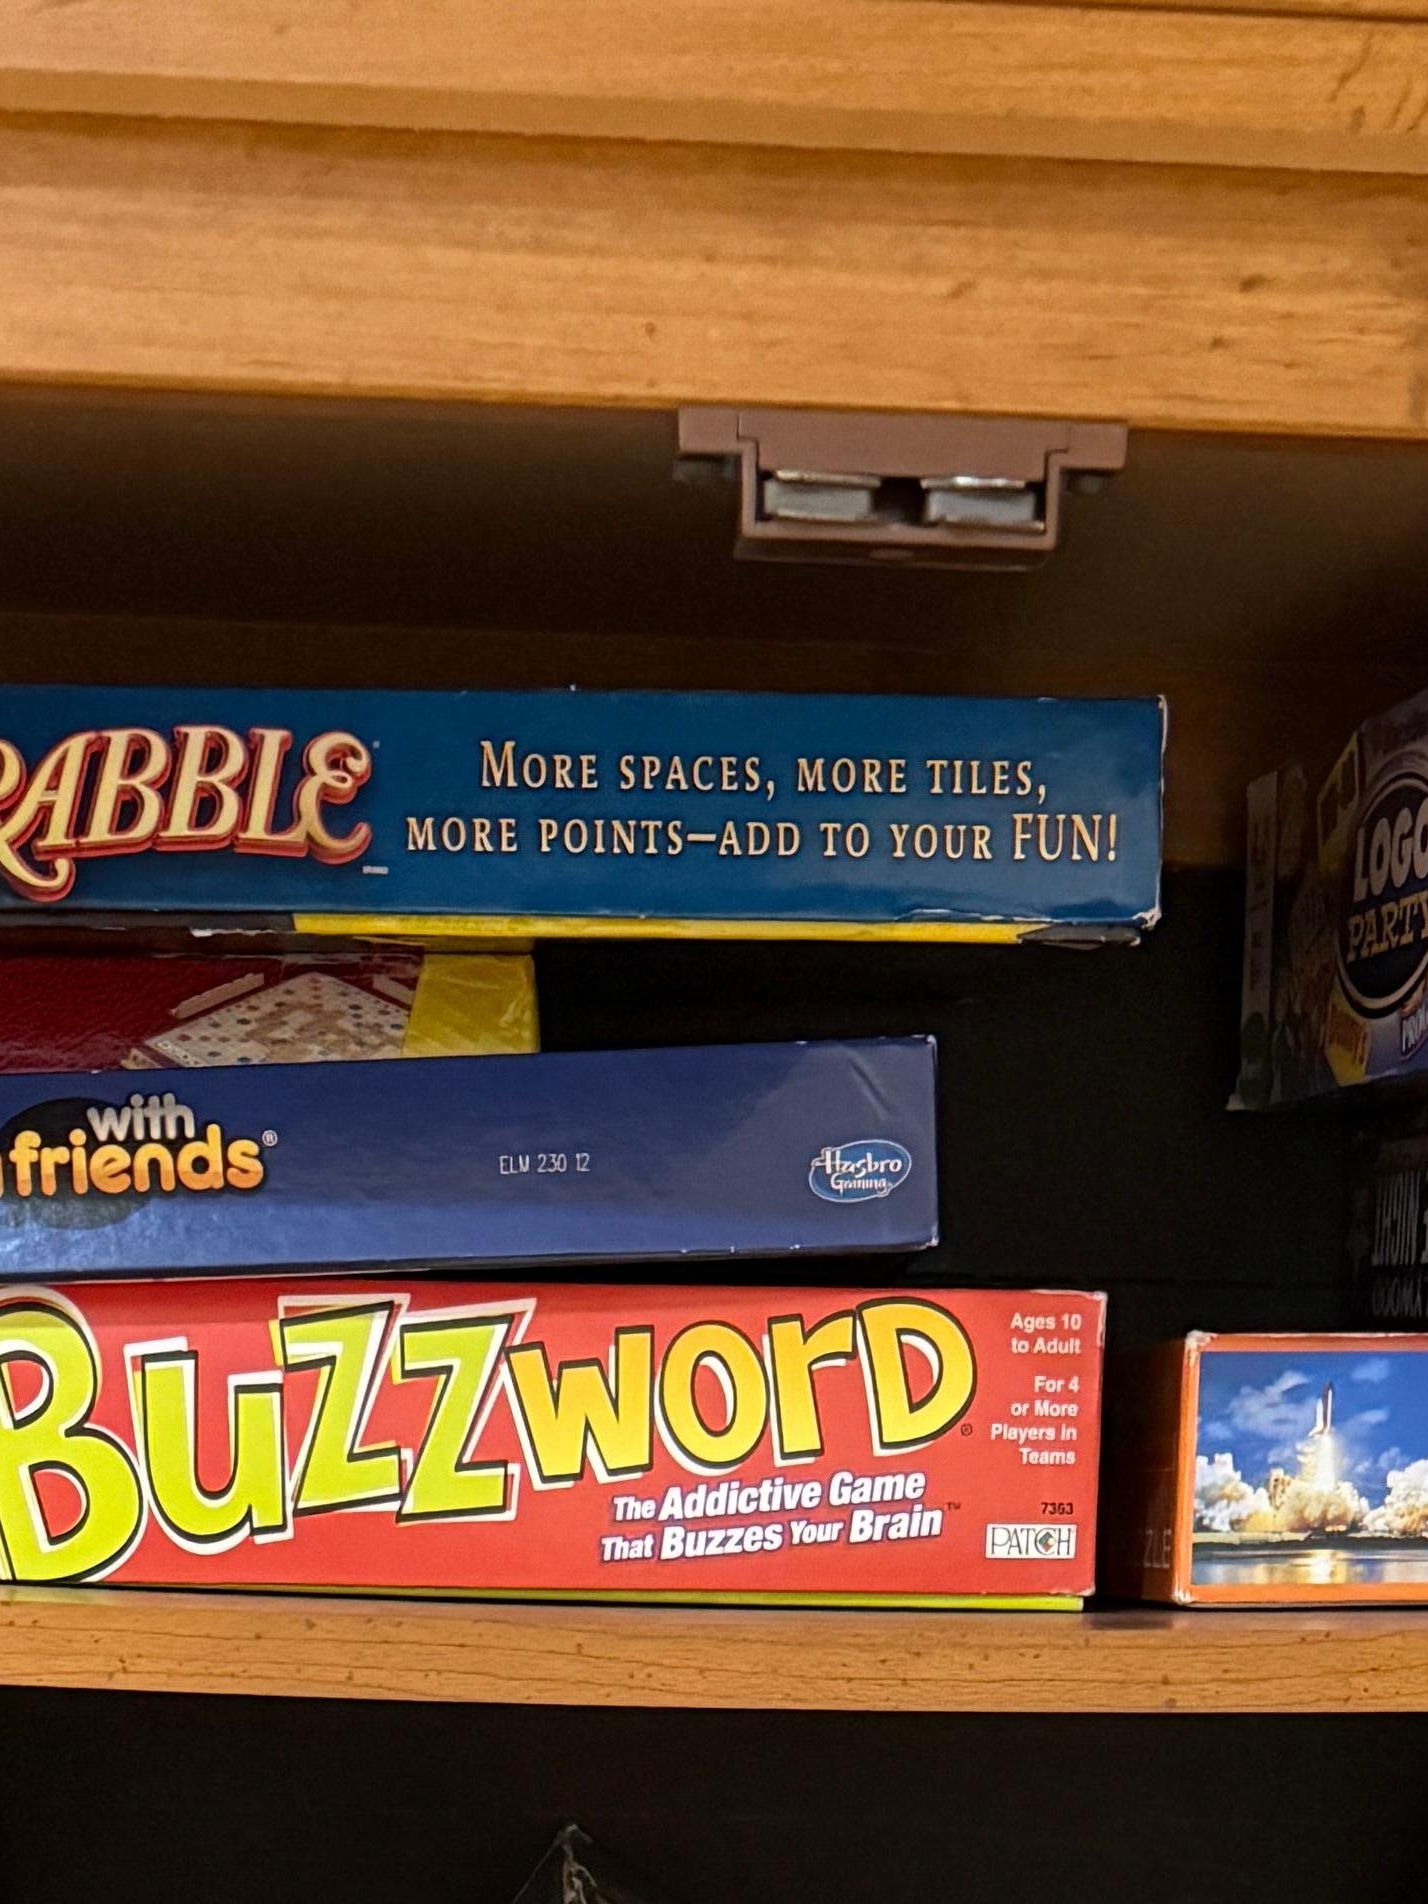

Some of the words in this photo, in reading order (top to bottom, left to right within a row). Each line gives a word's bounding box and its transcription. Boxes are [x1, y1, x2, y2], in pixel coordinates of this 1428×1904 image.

[86, 1094, 196, 1145] with
[1011, 1314, 1055, 1332] Ages
[1062, 1314, 1081, 1330] 10
[1012, 1338, 1028, 1354] to
[1034, 1338, 1081, 1354] Adult
[1035, 1376, 1064, 1392] For
[1069, 1377, 1079, 1392] 4
[1011, 1404, 1029, 1416] or
[1035, 1401, 1078, 1416] More
[1020, 1448, 1075, 1465] Teams
[614, 1497, 655, 1521] The
[659, 1476, 821, 1521] Addictive
[829, 1471, 925, 1503] Game
[601, 1536, 654, 1562] That
[659, 1521, 783, 1561] Buzzes
[790, 1521, 843, 1547] Your
[850, 1505, 942, 1544] Brain
[992, 1527, 1070, 1556] PATCH
